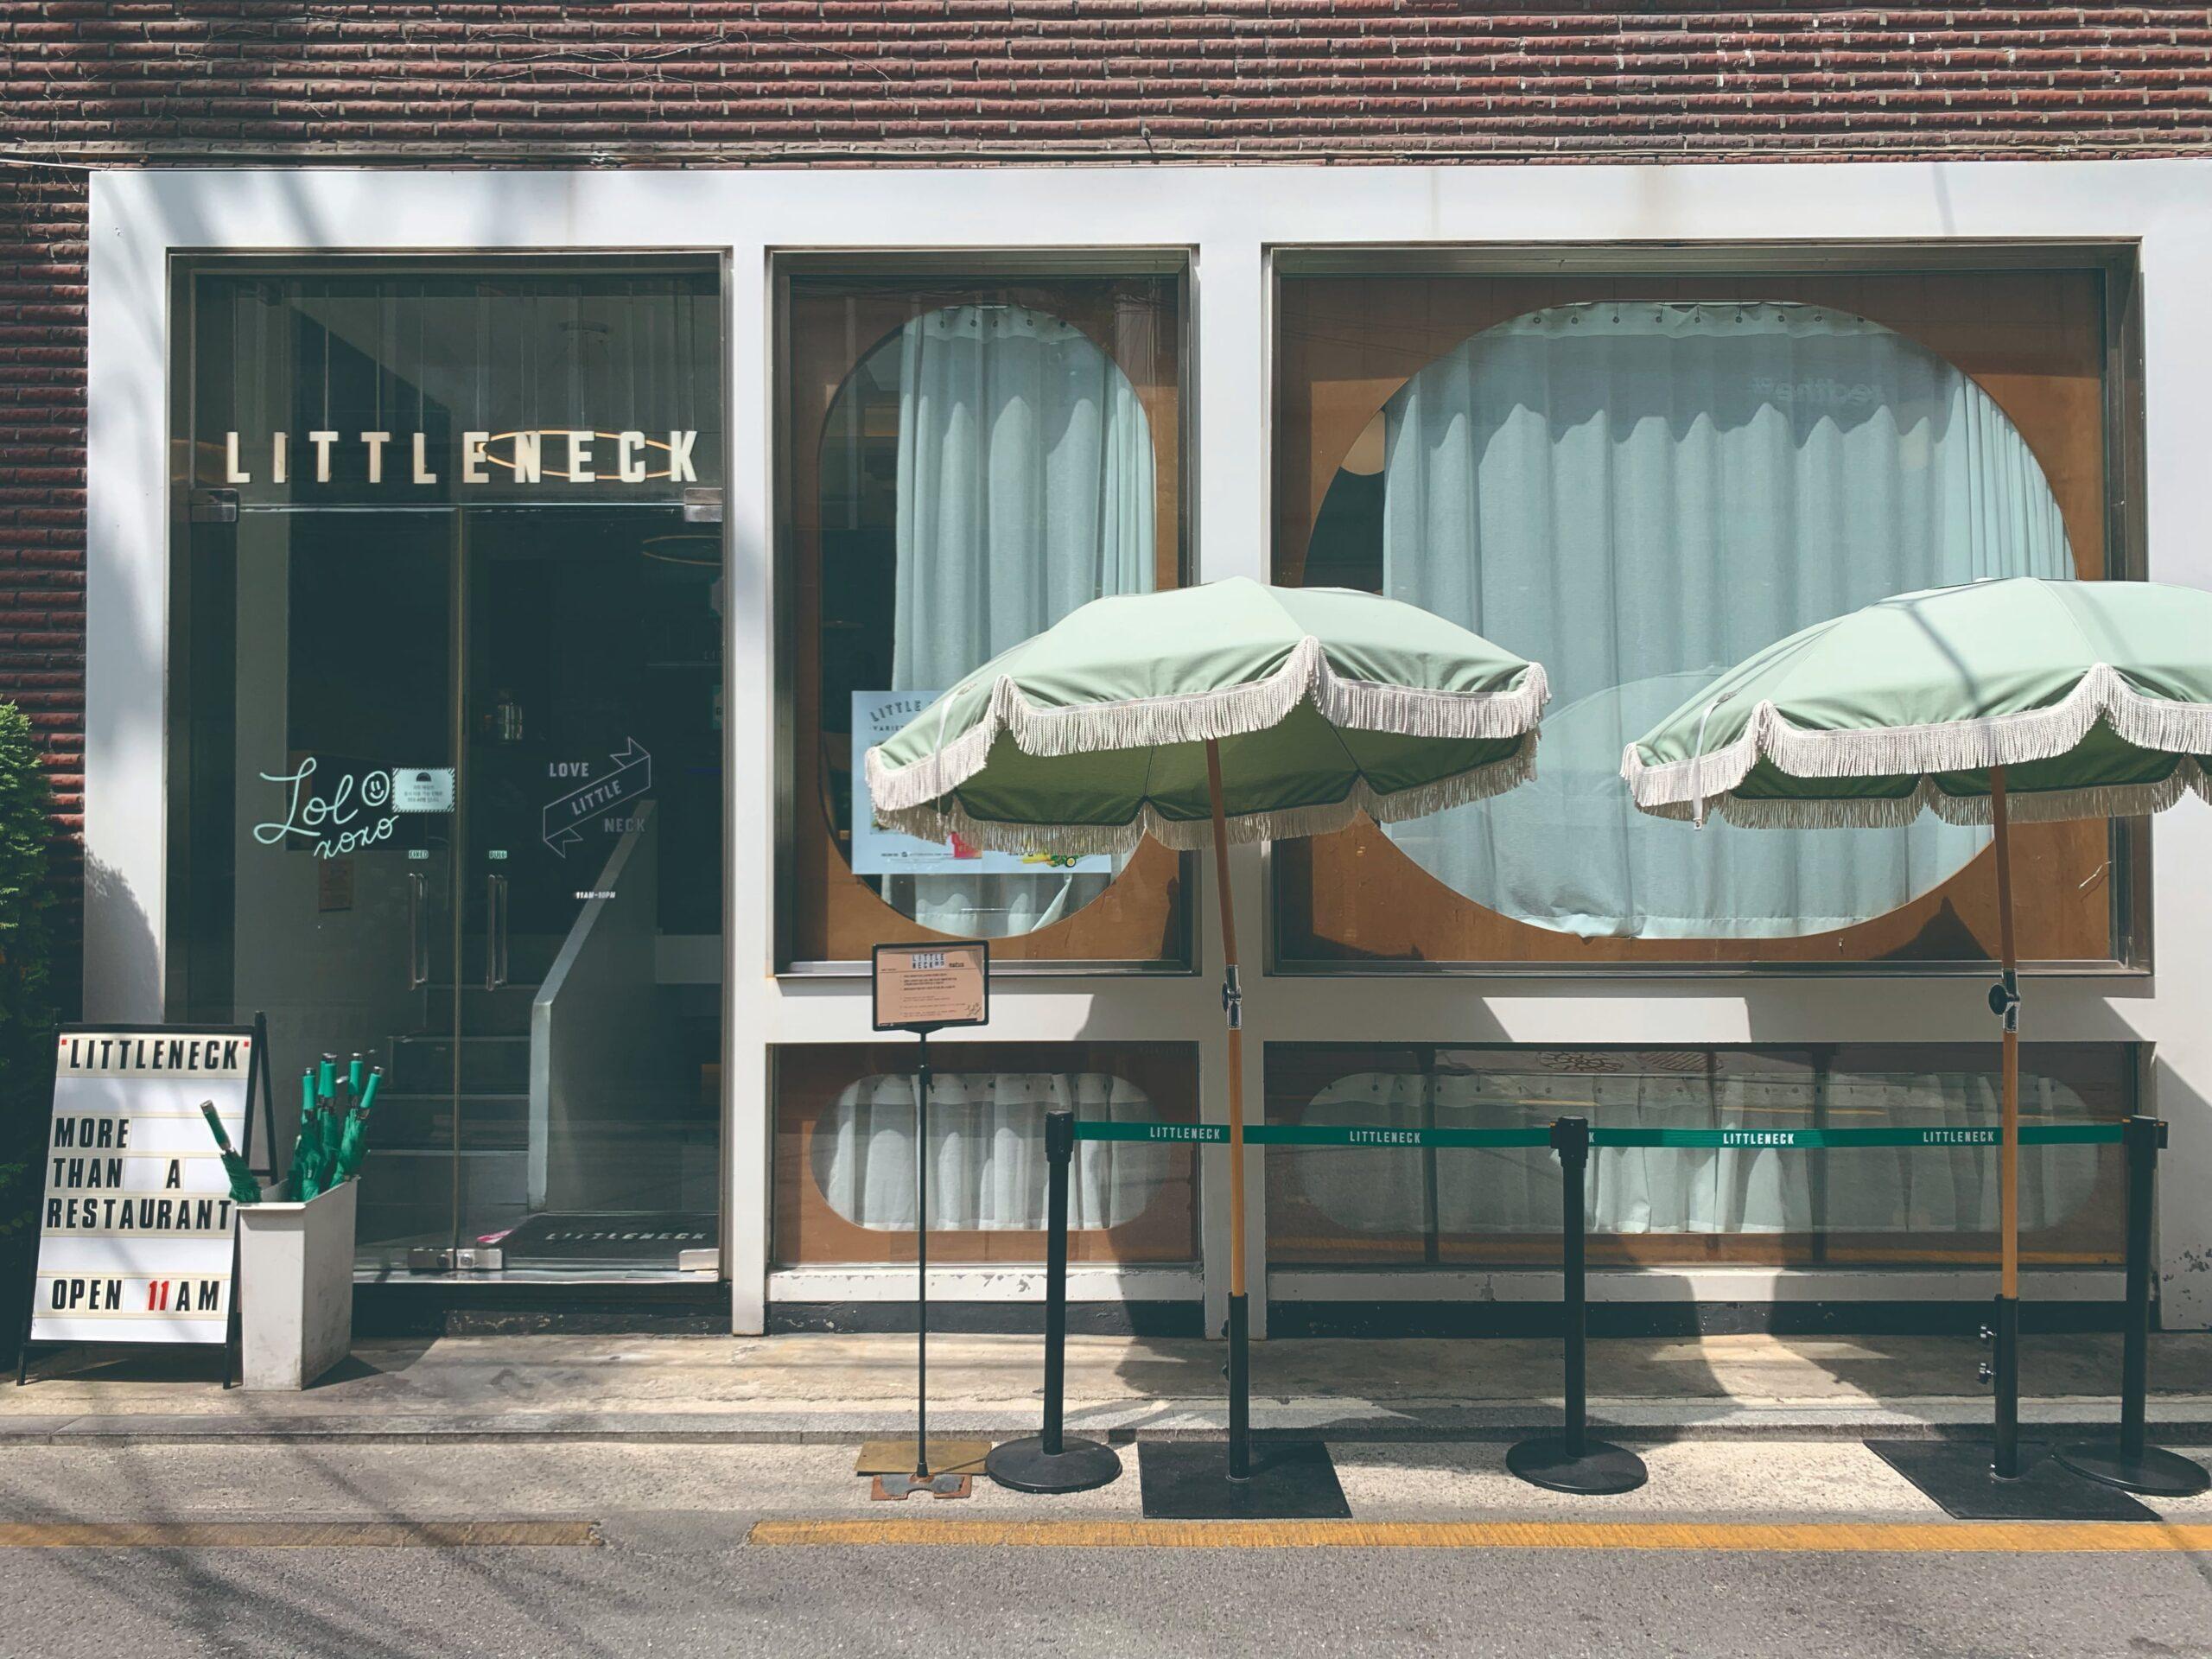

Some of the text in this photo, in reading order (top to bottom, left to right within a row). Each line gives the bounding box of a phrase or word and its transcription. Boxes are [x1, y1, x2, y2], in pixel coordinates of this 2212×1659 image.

[226, 431, 698, 485] LITTLENECK
[869, 700, 921, 721] LITTLE
[550, 762, 589, 778] LOVE
[571, 779, 622, 816] LITTLE
[604, 817, 645, 833] NECK
[70, 1039, 238, 1070] LITTLENECK
[55, 1117, 130, 1148] MORE
[1149, 1127, 1221, 1140] LITTLENECK
[1350, 1131, 1421, 1144] LITTLENECK
[1723, 1133, 1795, 1146] LITTLENECK
[1923, 1131, 1994, 1142] LITTLENECK
[53, 1157, 181, 1189] THAN A
[47, 1198, 232, 1230] RESTAURANT
[52, 1279, 122, 1310] OPEN
